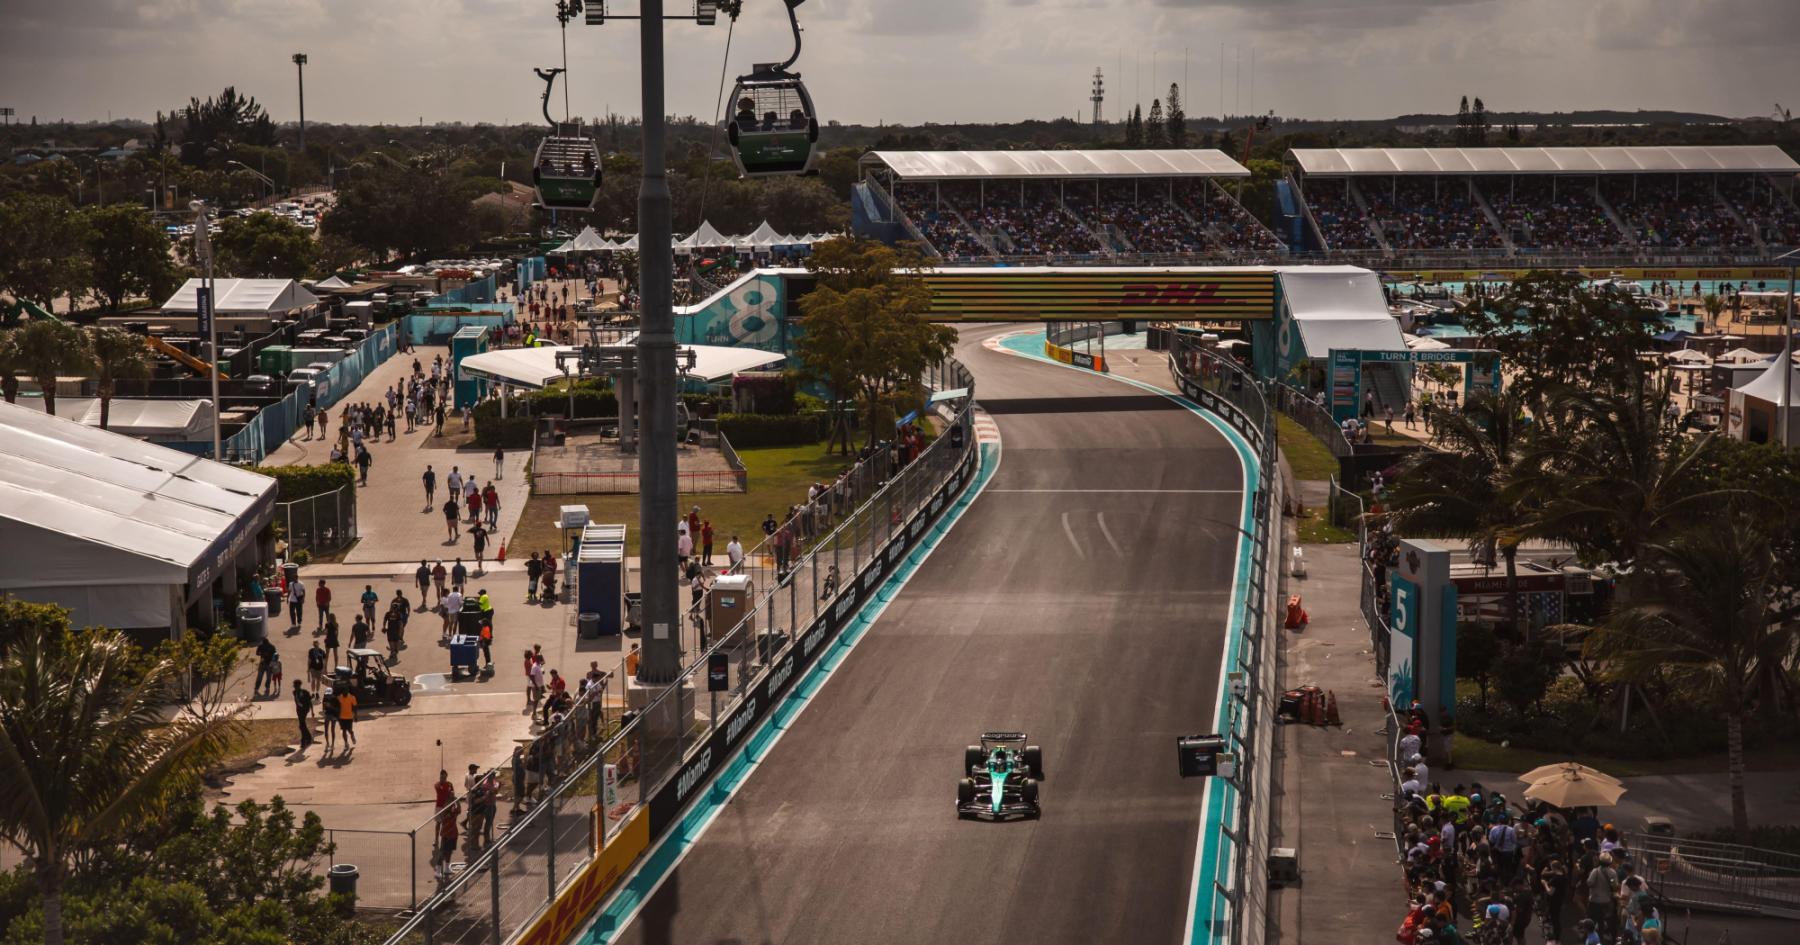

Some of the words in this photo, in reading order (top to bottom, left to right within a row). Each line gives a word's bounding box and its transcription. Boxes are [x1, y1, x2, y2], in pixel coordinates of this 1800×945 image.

[729, 279, 778, 343] 8
[1120, 283, 1226, 304] DHL
[1380, 352, 1406, 361] TURN
[1409, 352, 1417, 361] 8
[1421, 352, 1457, 361] BRIDGE
[1395, 587, 1408, 631] 5
[768, 656, 794, 698] #MiamiGP
[726, 698, 756, 746] #MiamiGP
[676, 746, 712, 801] #MiamiGP
